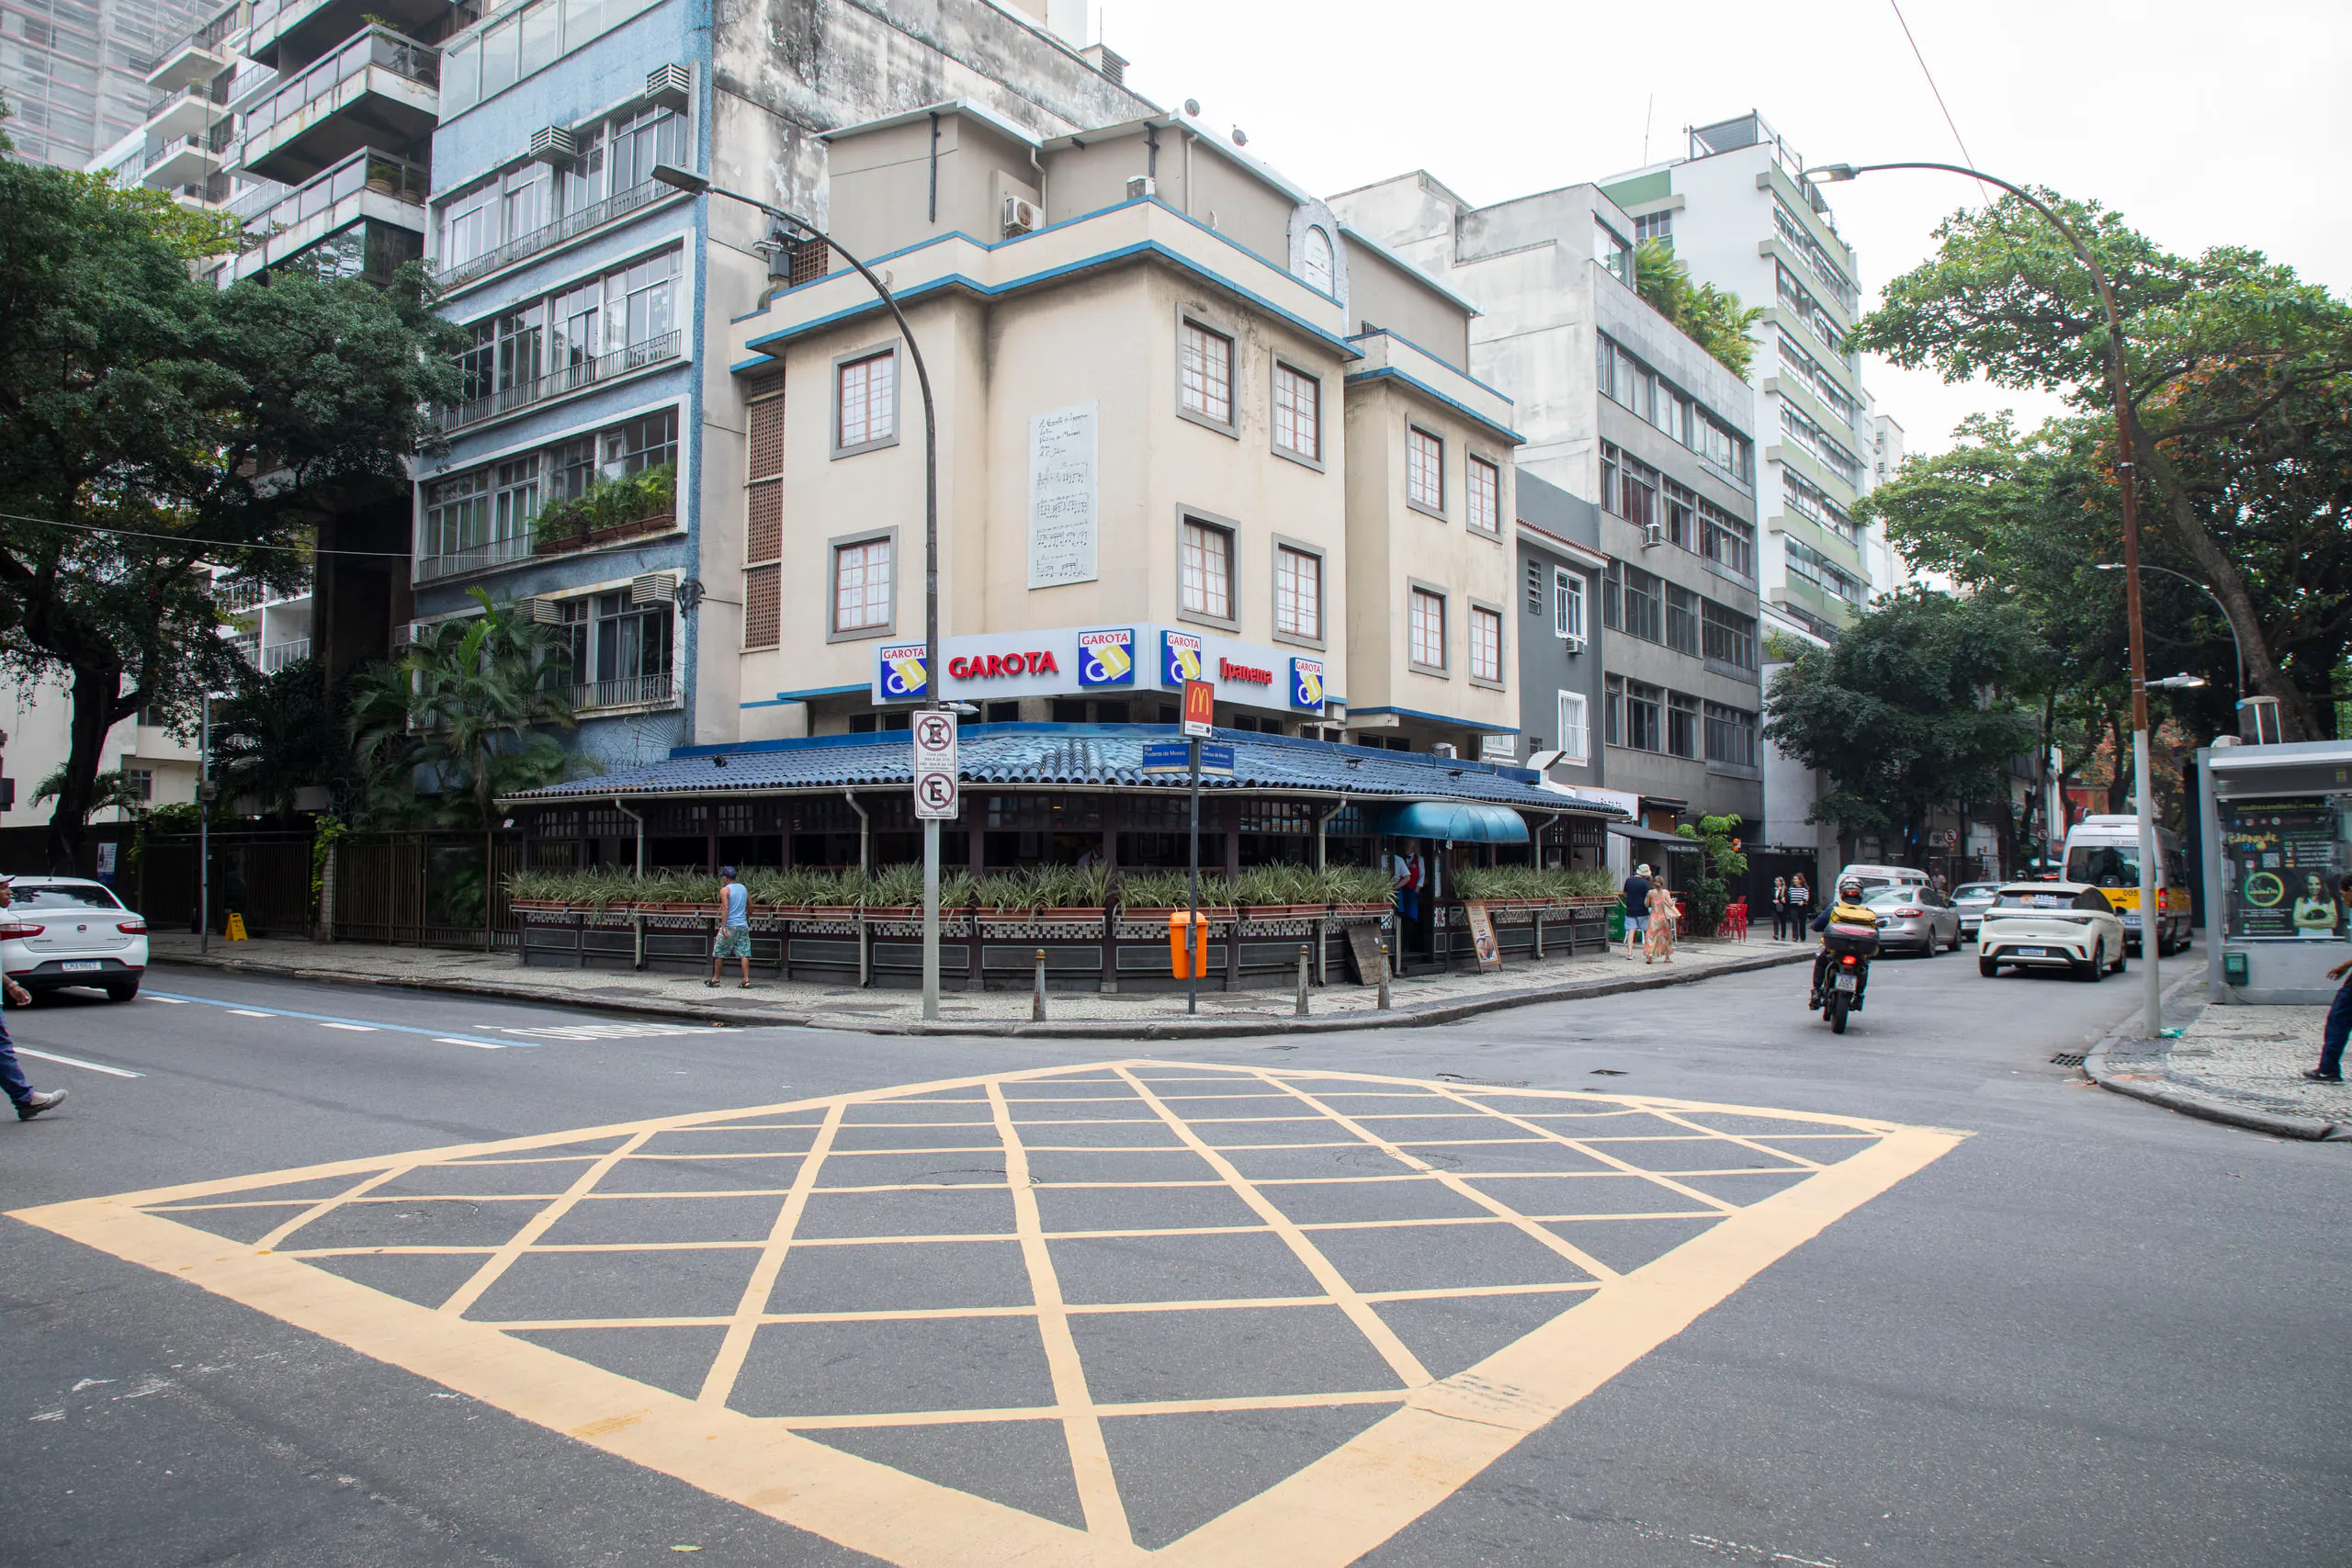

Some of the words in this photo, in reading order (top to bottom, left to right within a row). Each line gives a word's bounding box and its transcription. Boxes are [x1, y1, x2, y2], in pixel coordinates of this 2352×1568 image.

[1081, 633, 1129, 646] GAROTA
[1168, 635, 1200, 649] GAROTA
[883, 648, 925, 660] GAROTA
[948, 650, 1059, 679] GAROTA
[1219, 657, 1273, 684] Ipanema
[1295, 660, 1321, 674] GAROTA
[930, 781, 943, 801] E
